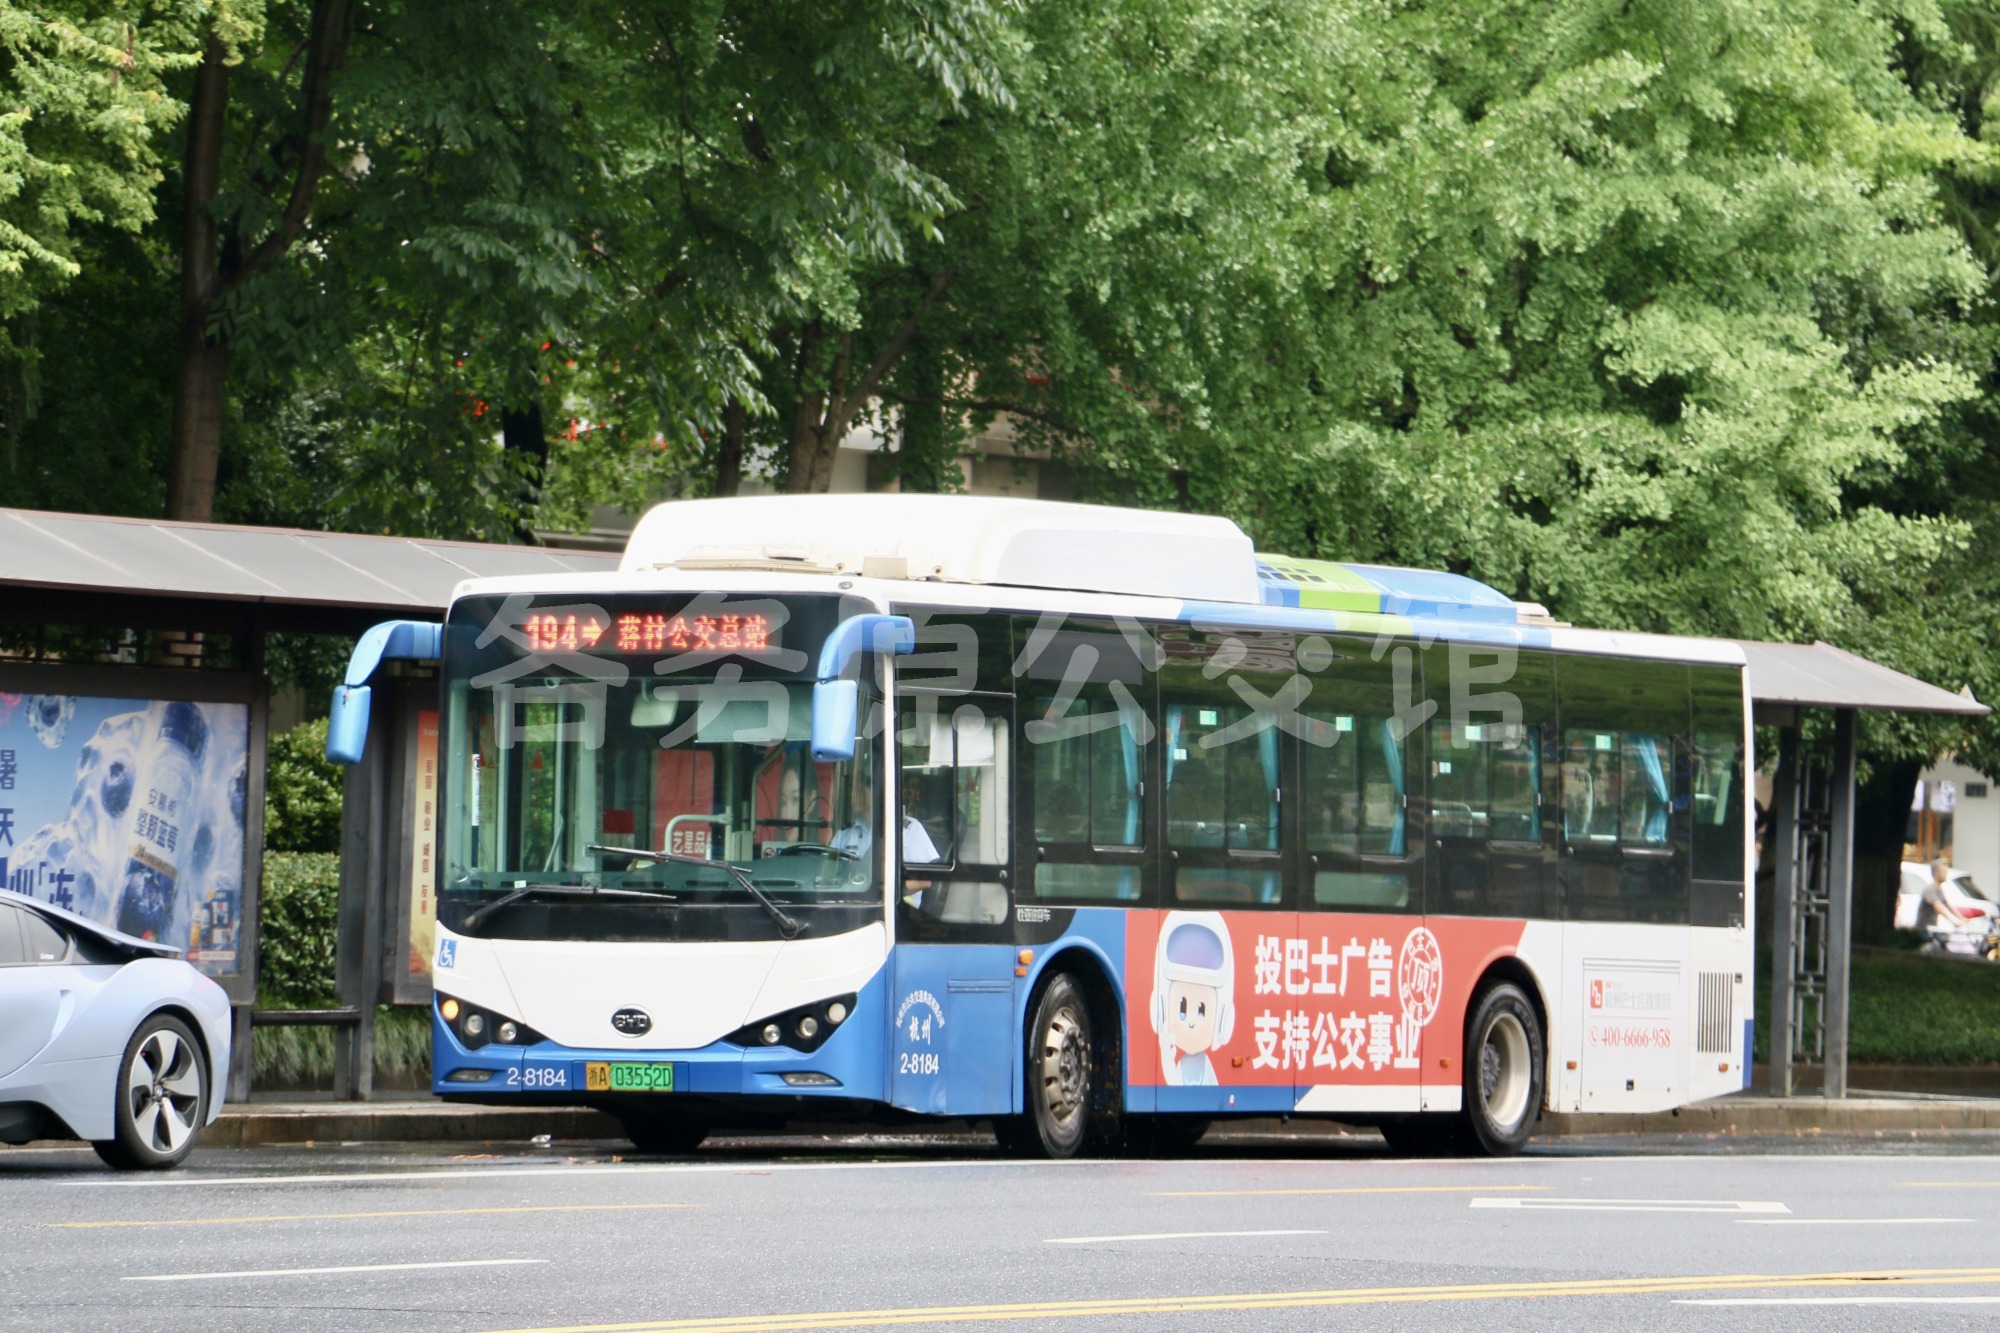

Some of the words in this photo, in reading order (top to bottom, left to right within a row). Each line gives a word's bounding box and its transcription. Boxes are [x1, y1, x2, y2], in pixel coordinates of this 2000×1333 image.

[527, 615, 577, 650] 194
[617, 614, 768, 650] 蒋村公交总站
[1255, 934, 1393, 997] 投巴士广告
[615, 1014, 648, 1028] BYD
[909, 1013, 932, 1046] 杭州
[1252, 1009, 1420, 1071] 支持公交事业
[1602, 1026, 1671, 1048] 400-6666-958
[506, 1066, 567, 1087] 2-8184
[900, 1052, 939, 1074] 2-8184
